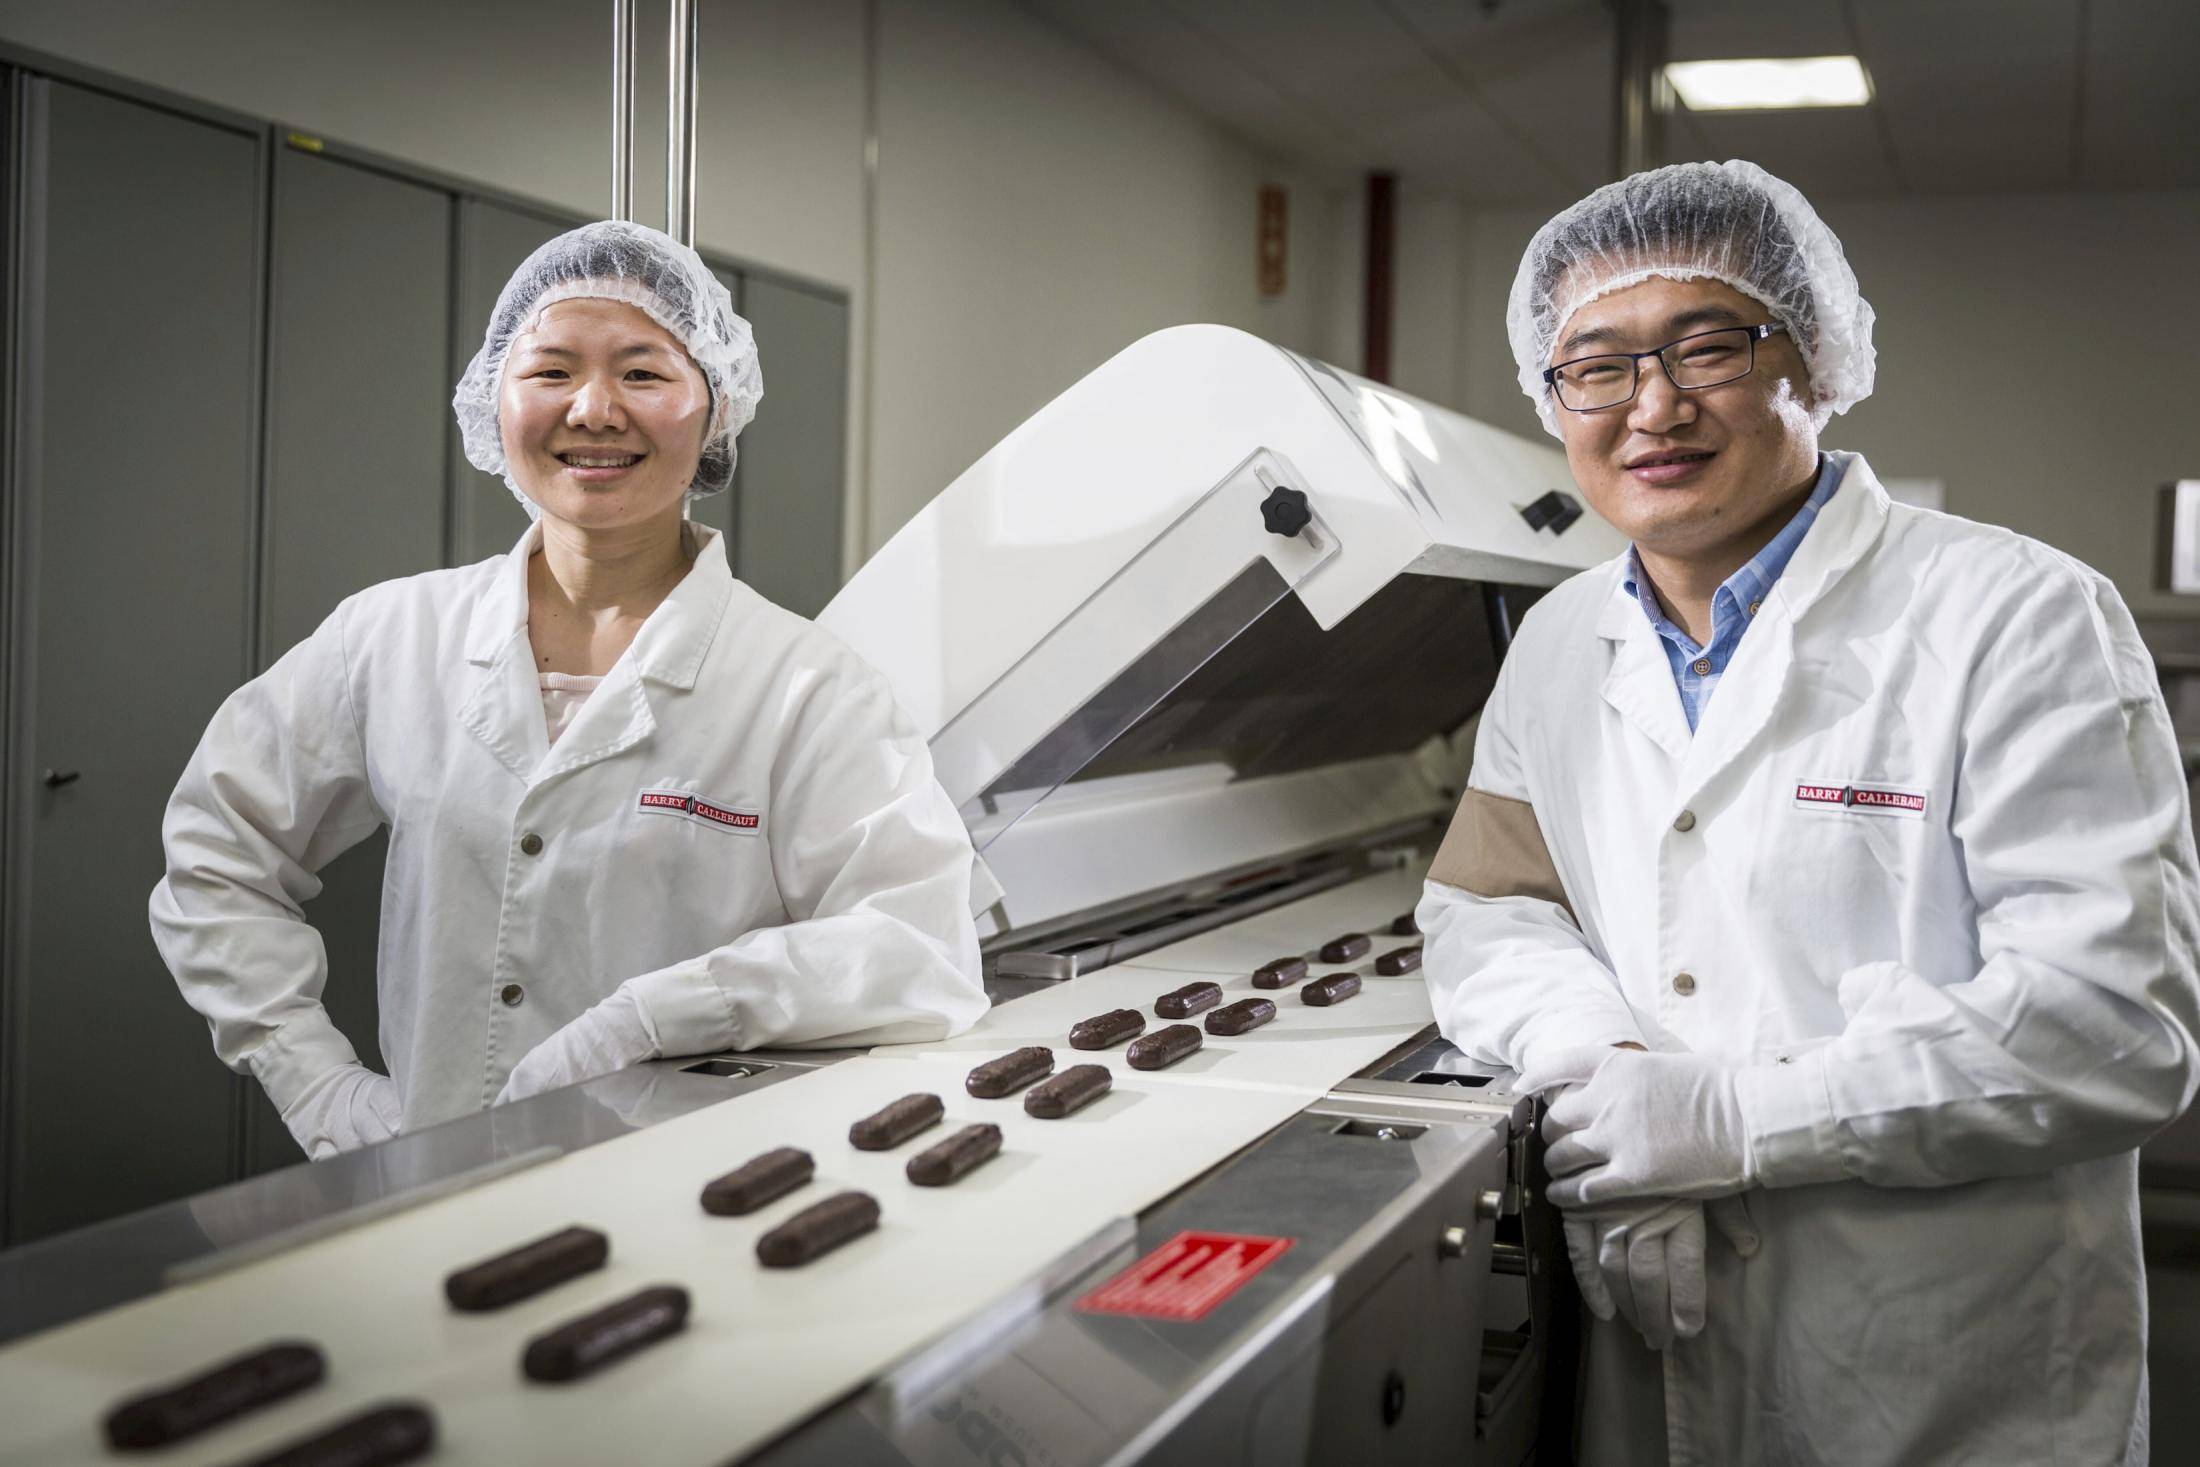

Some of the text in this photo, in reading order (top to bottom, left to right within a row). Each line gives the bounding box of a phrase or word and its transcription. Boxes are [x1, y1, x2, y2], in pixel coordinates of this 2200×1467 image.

[1799, 787, 1841, 801] BARRY
[643, 794, 756, 826] BARRY CALLEBAUT
